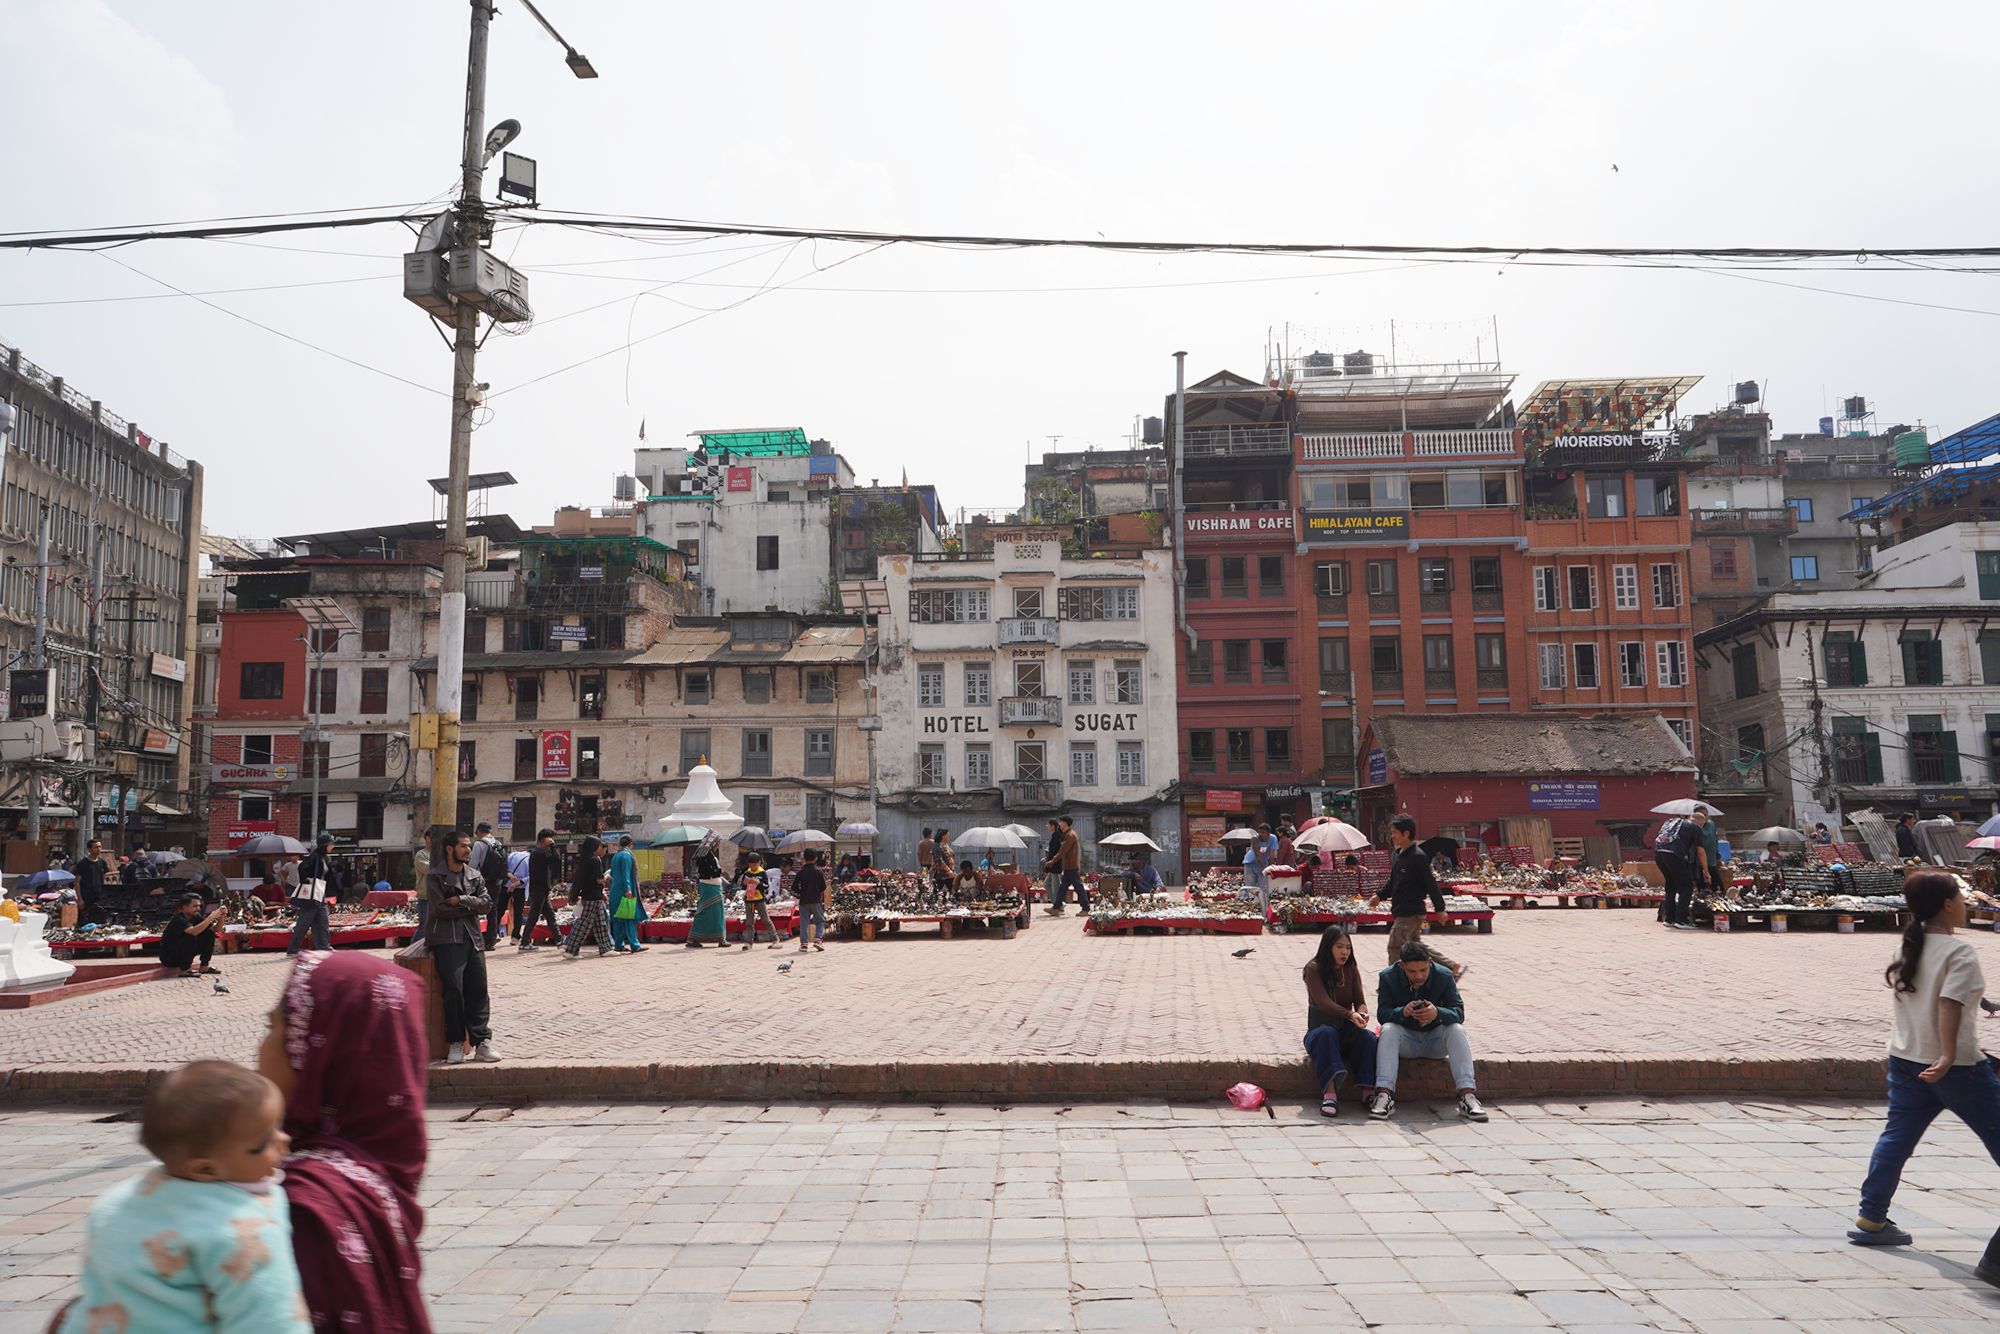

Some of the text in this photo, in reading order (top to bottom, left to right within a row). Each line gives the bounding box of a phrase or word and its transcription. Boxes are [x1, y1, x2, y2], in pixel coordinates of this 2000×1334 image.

[1555, 434, 1633, 448] MORRISON
[1187, 517, 1292, 531] VISHRAM CAFE
[1309, 516, 1404, 529] HIMALAYAN CAFE
[924, 713, 1138, 733] HOTEL SUGAT
[229, 831, 248, 839] MONEY
